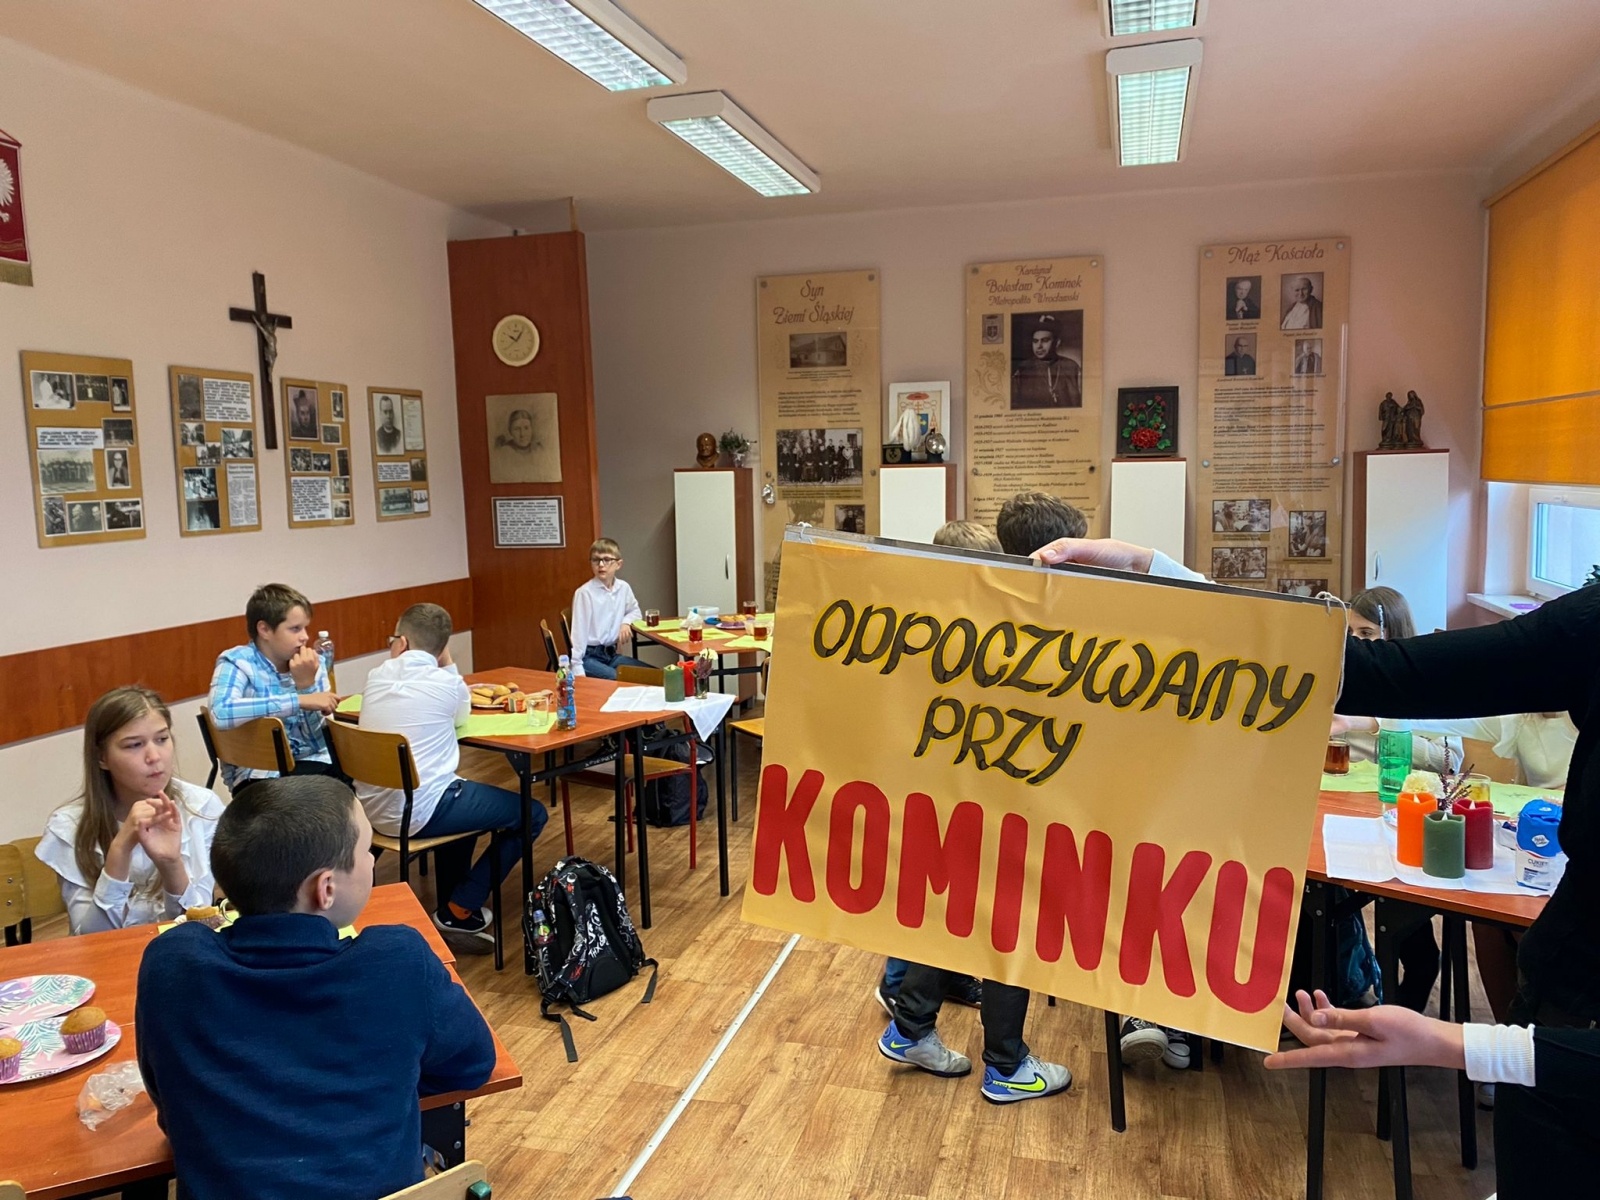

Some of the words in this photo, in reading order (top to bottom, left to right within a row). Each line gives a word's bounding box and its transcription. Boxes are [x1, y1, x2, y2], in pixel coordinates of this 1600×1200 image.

[1228, 246, 1260, 265] Mąż
[1265, 243, 1324, 262] Kościoła
[800, 279, 824, 301] Syn
[986, 278, 1033, 293] Bolesław
[1036, 275, 1082, 291] Kominek
[773, 306, 807, 324] Ziemi
[809, 301, 854, 325] Śląskiej
[812, 599, 1316, 732] ODPOCZYWAMY
[913, 695, 1084, 786] PRZY
[752, 763, 1295, 1014] KOMINKU
